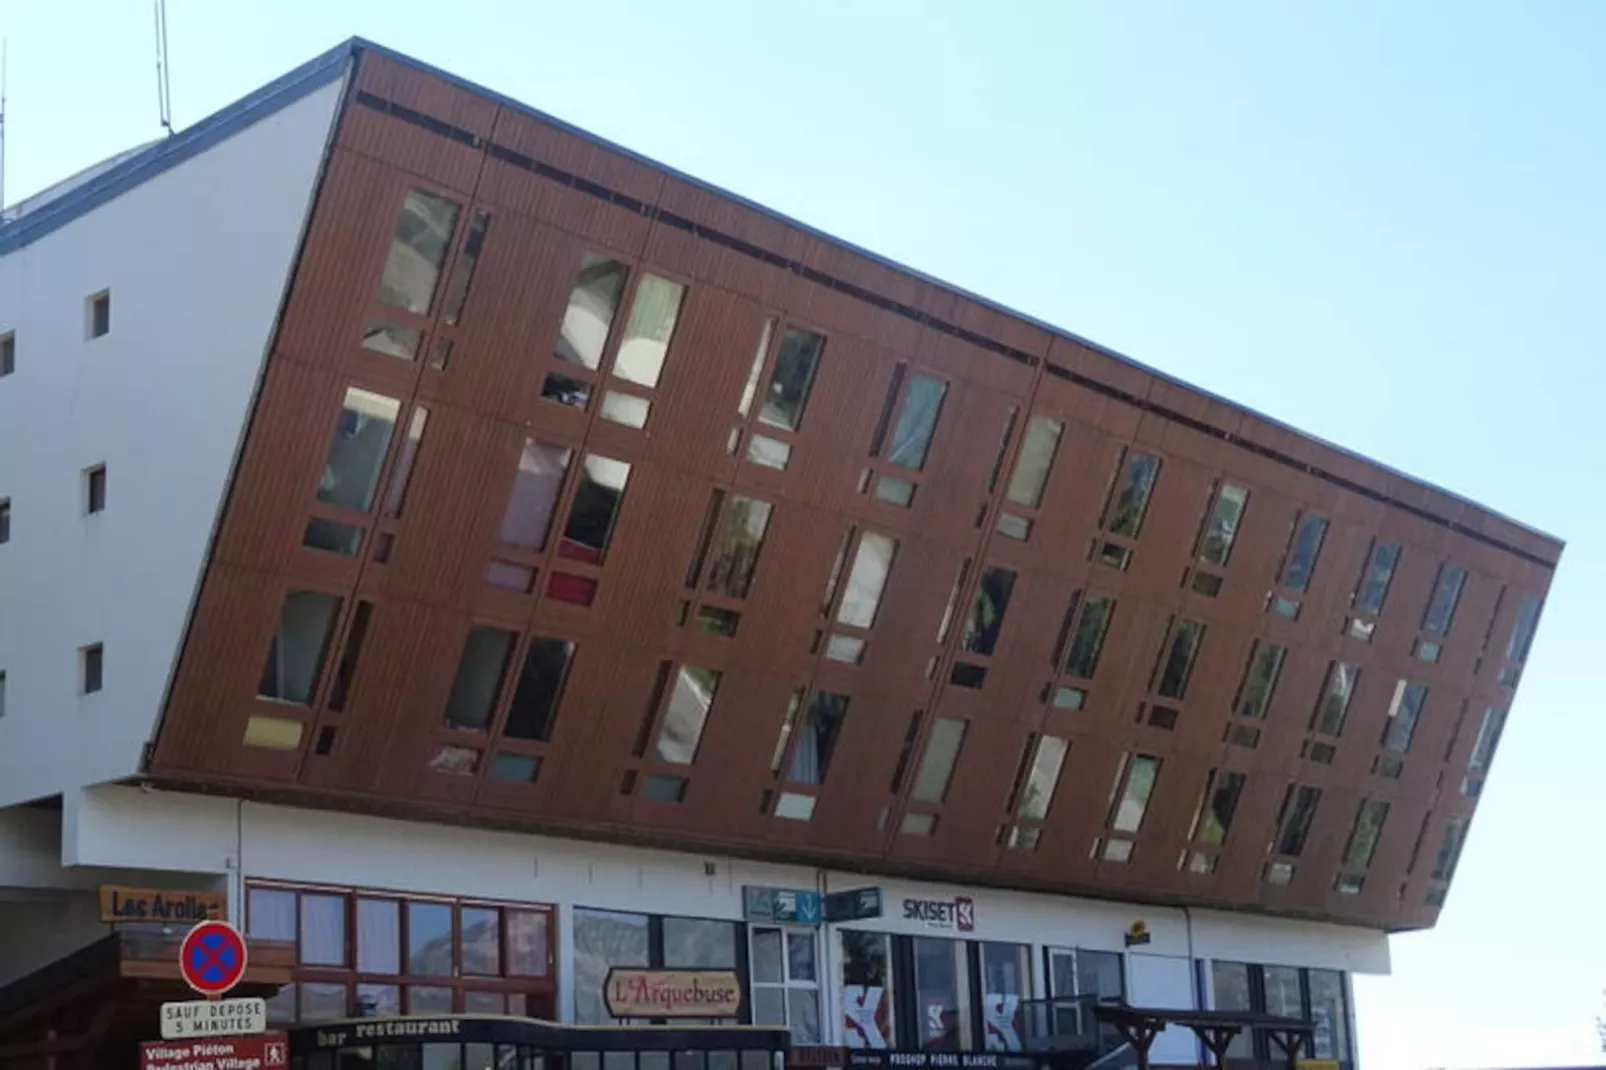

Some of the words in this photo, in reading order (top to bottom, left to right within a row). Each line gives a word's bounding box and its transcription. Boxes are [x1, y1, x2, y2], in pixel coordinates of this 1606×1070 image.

[903, 898, 955, 921] SKISET
[614, 975, 735, 1010] L'Arquebuse
[166, 1006, 199, 1018] SAUF
[176, 1023, 183, 1033] 5
[193, 1019, 252, 1032] MINUTES
[317, 1030, 346, 1047] bar
[355, 1019, 460, 1037] restaurant
[145, 1047, 190, 1060] Village
[192, 1043, 234, 1056] Piéton
[216, 1058, 260, 1070] Village
